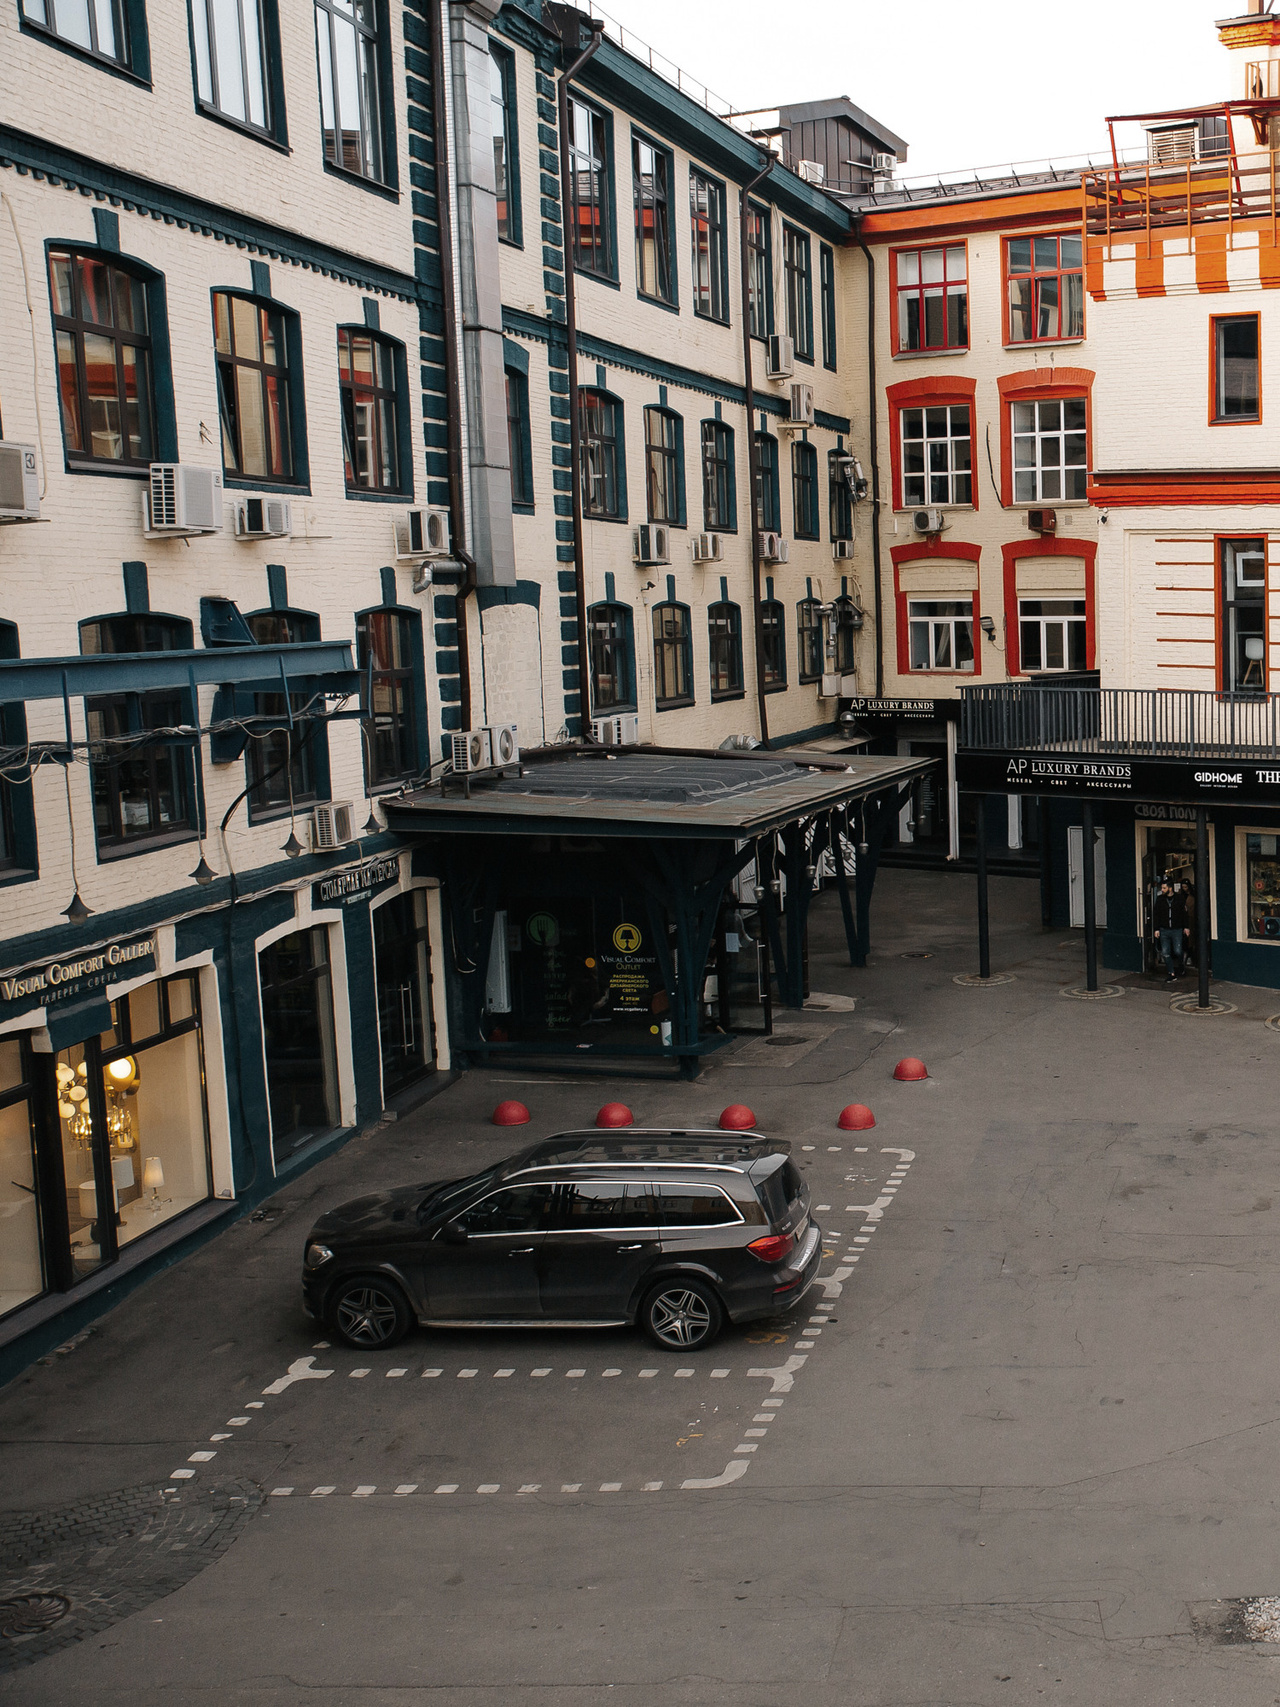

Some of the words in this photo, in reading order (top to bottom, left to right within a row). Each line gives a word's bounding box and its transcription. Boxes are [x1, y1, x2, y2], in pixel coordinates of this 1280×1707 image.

[851, 699, 866, 710] AP
[867, 701, 899, 709] LUXURY
[902, 702, 934, 710] BRANDS
[1007, 759, 1027, 774] AP
[1031, 762, 1079, 774] LUXURY
[1083, 765, 1132, 777] BRANDS
[1194, 772, 1243, 784] GIDHOME
[1134, 803, 1166, 819] СВОЯ
[601, 955, 624, 963] VISUAL
[624, 955, 656, 963] COMFORT
[616, 962, 641, 970] OUTLET
[3, 977, 48, 1001] VISUAL
[49, 955, 106, 985] COMFORT
[108, 939, 157, 966] GALLERY
[40, 984, 80, 1006] ГАЛЕРЕЯ
[87, 971, 118, 988] СВЕТА
